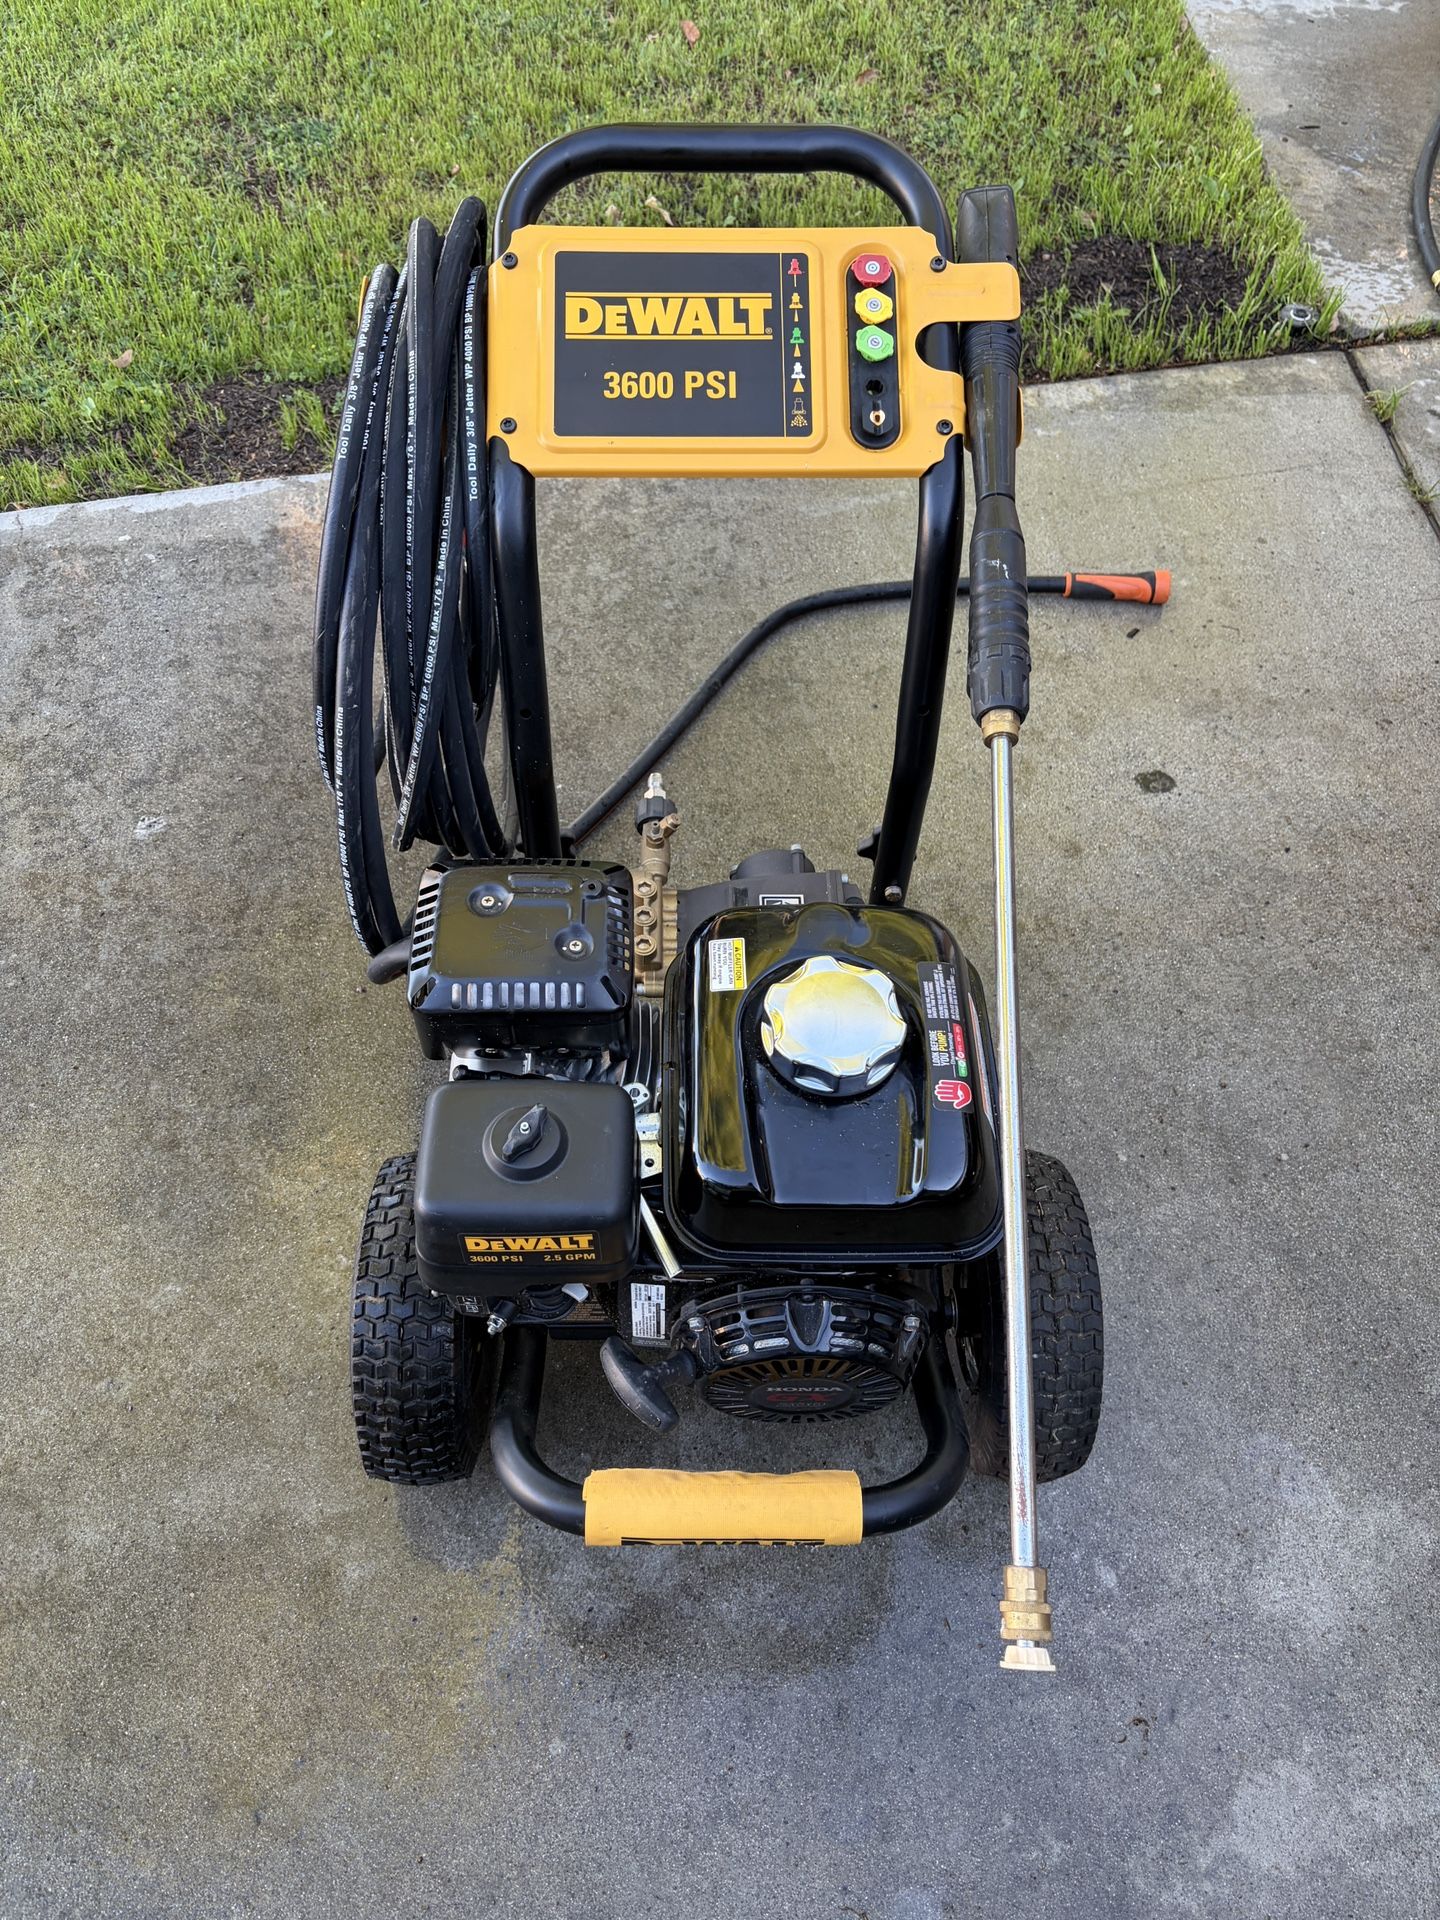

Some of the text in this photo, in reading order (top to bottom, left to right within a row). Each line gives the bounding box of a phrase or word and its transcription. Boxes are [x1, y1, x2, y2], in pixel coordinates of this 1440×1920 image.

[364, 301, 375, 314] PSI
[464, 312, 473, 323] BP
[565, 296, 773, 335] DEWALT
[360, 314, 371, 333] 4000
[464, 326, 472, 340] PSI
[357, 333, 368, 348] WP
[464, 341, 473, 362] 4000
[352, 351, 365, 379] Jetter
[465, 363, 473, 380] WP
[348, 380, 359, 401] 3/8"
[603, 370, 736, 399] 3600 PSI
[465, 383, 474, 414] Jetter
[342, 404, 356, 432] Daily
[466, 415, 475, 438] 3/8"
[337, 437, 350, 460] Tool
[467, 443, 477, 471] Daily
[469, 476, 478, 502] Tool
[442, 496, 451, 526] China
[438, 541, 448, 570] Made
[433, 588, 442, 607] 176
[430, 610, 440, 632] Max
[427, 636, 437, 654] PSI
[423, 655, 434, 684] 16000
[421, 686, 429, 701] BP
[315, 705, 323, 728] China
[336, 706, 344, 736] China
[418, 704, 427, 721] PSI
[414, 721, 423, 742] 4000
[411, 742, 420, 757] WP
[335, 750, 343, 776] Made
[406, 759, 417, 783] Jetter
[336, 790, 344, 807] 176
[337, 808, 345, 826] Max
[338, 828, 346, 844] PSI
[340, 844, 349, 866] 16000
[342, 867, 350, 878] BP
[343, 879, 352, 892] PSI
[929, 1030, 938, 1051] BEFORE
[937, 1030, 948, 1052] PUMP!
[931, 1052, 941, 1066] LOOK
[939, 1052, 950, 1065] YOU
[465, 1234, 593, 1251] DEWALT
[469, 1253, 596, 1263] 3600 PSI 2.5 GPM
